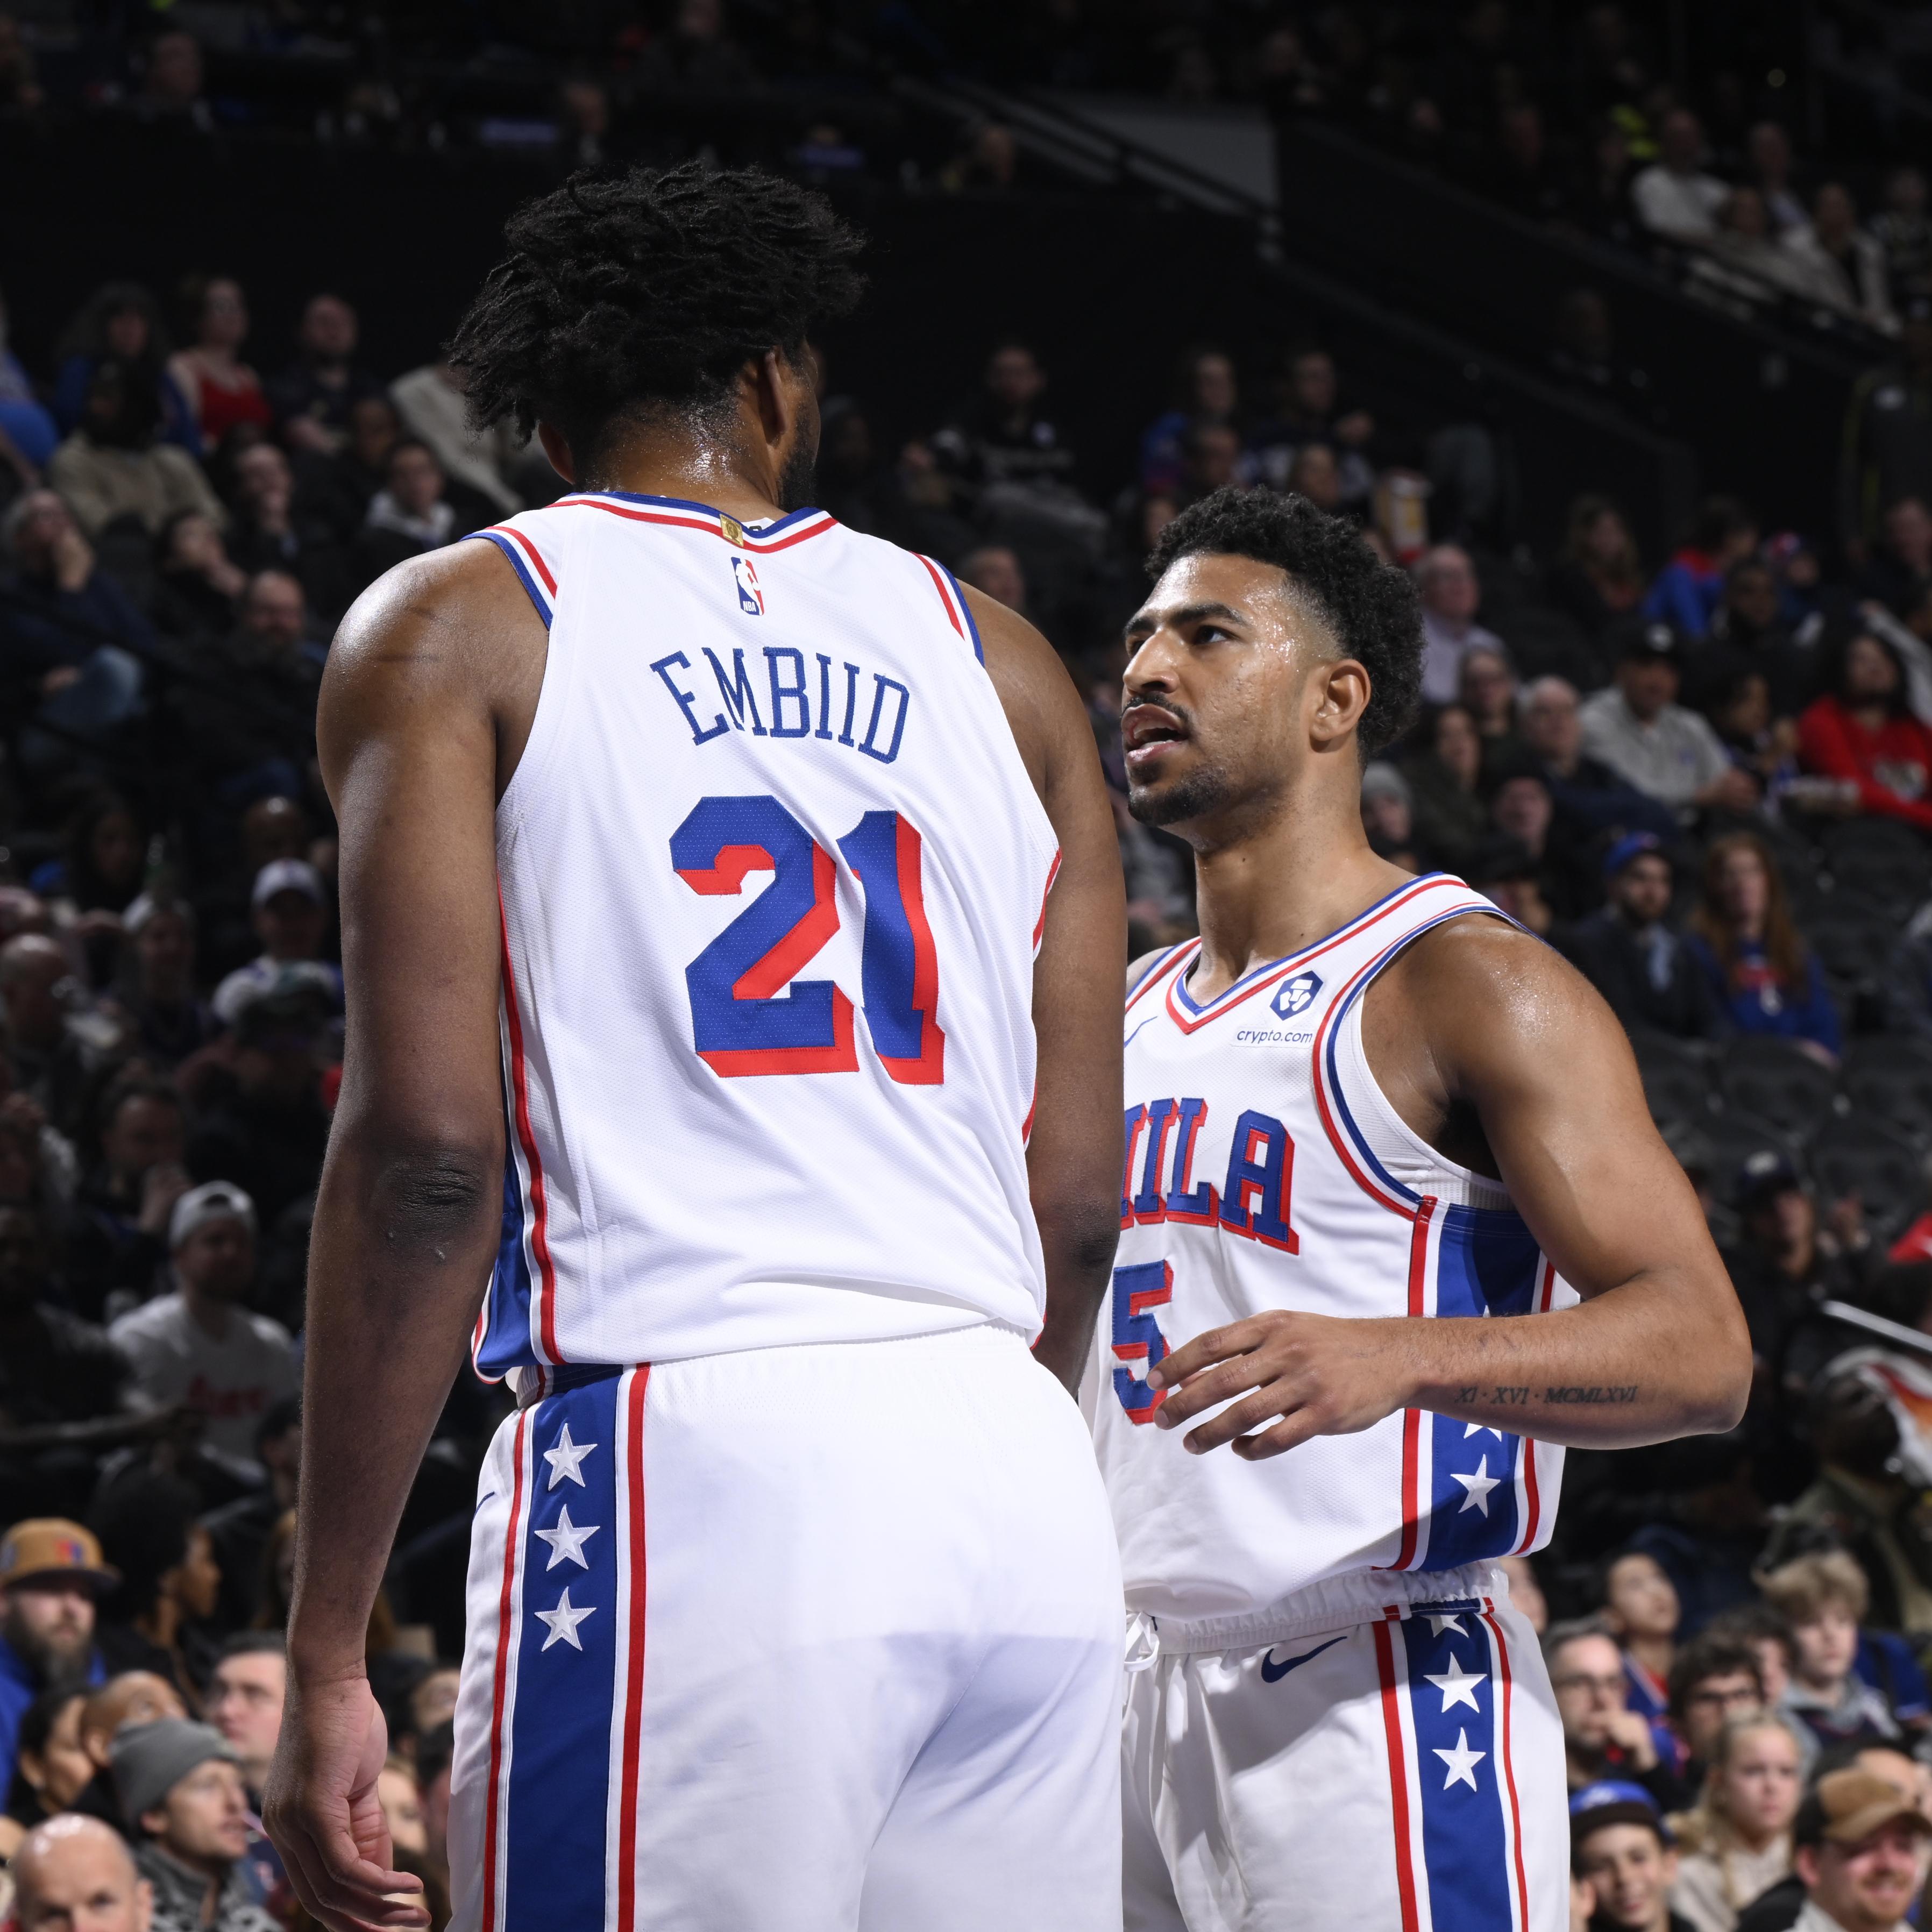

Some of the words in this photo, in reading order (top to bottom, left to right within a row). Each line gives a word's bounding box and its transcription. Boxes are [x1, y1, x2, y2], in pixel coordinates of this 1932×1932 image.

[743, 601, 756, 612] NBA
[649, 647, 910, 764] EMBIID
[669, 795, 946, 1085] 21
[1237, 1029, 1313, 1044] crypto.com
[1111, 1259, 1174, 1425] 5
[1454, 1386, 1478, 1403] XI
[1490, 1386, 1530, 1405] XVI
[1544, 1386, 1638, 1404] MCMLXVI
